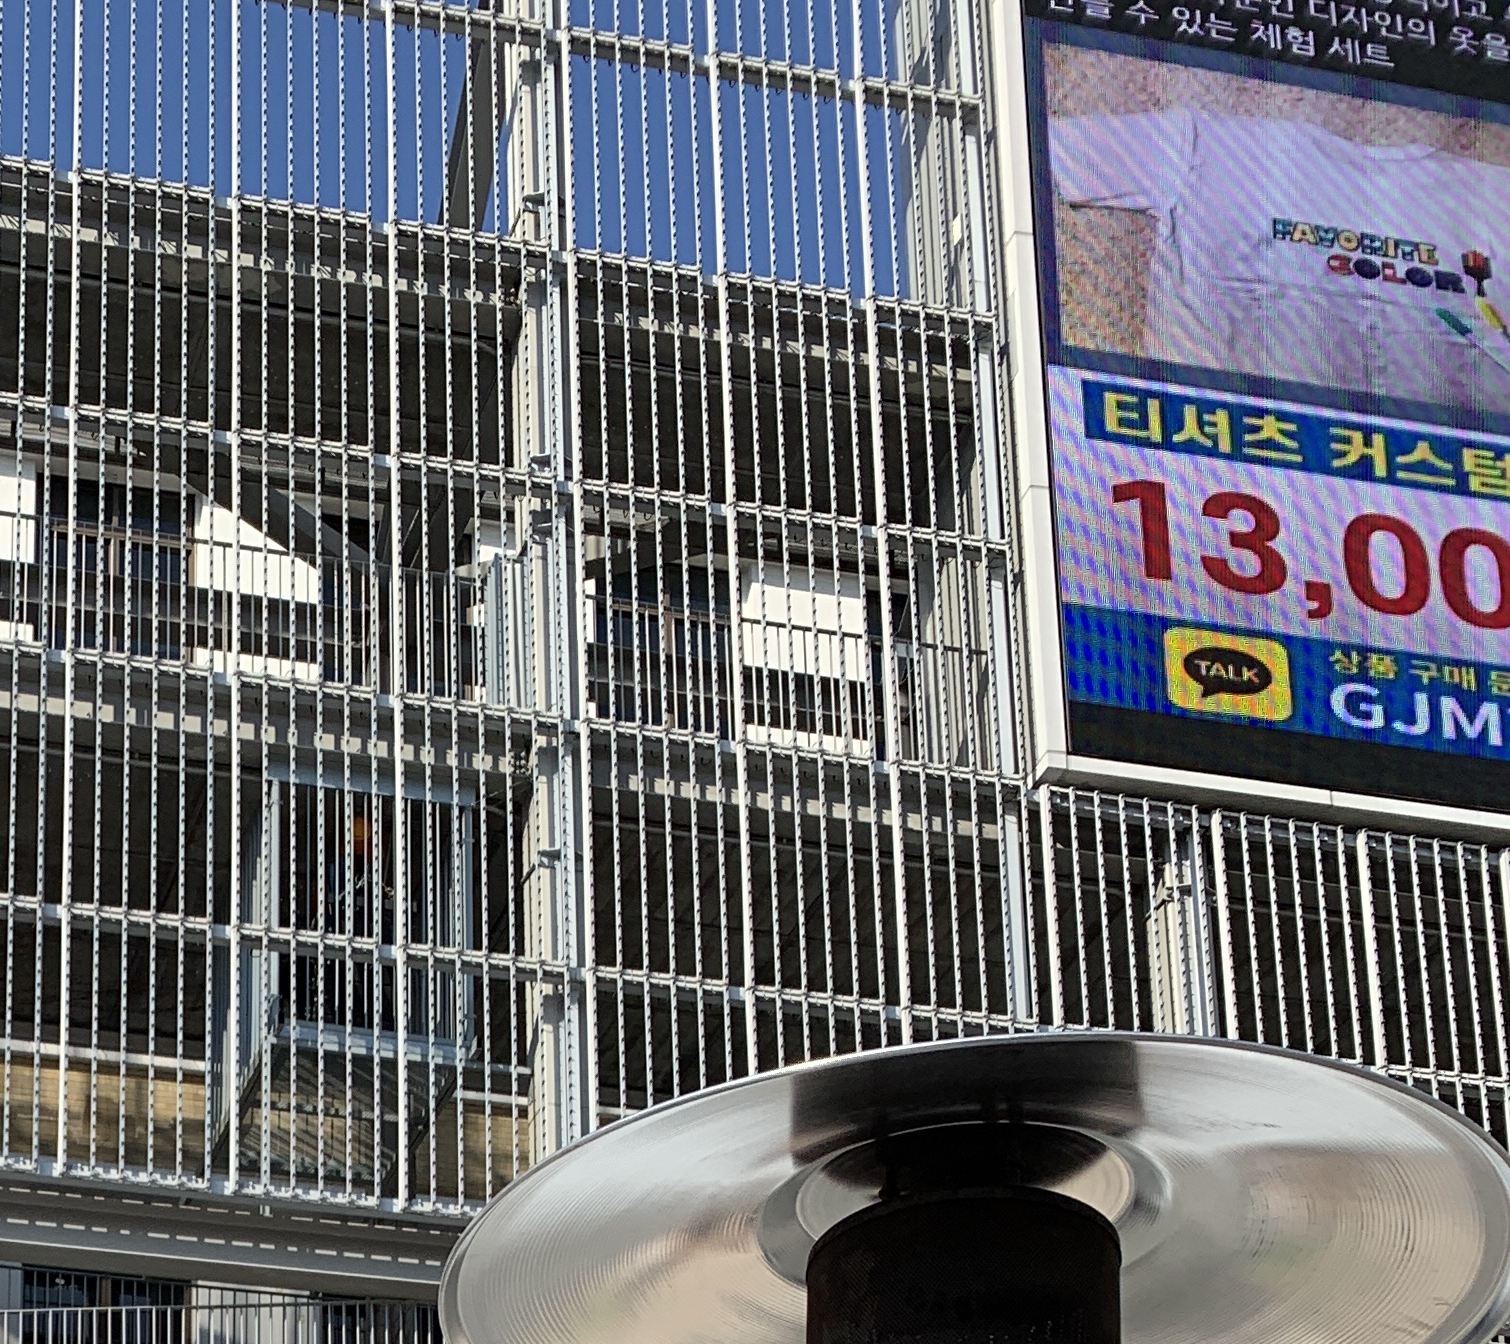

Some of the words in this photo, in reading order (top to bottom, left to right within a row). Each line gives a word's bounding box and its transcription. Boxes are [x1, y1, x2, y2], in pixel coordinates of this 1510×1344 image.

[1125, 2, 1160, 25] 수
[1172, 6, 1238, 42] 있는
[1250, 19, 1315, 57] 체험
[1327, 36, 1395, 67] 세트
[1309, 0, 1436, 46] 디자인의
[1273, 217, 1439, 266] FAVORITE
[1327, 253, 1466, 294] COLOR
[1102, 391, 1304, 464] 티셔츠
[1111, 478, 1510, 631] 13,00
[1194, 660, 1259, 686] TALK
[1328, 649, 1397, 680] 상품
[1408, 658, 1478, 692] 구매
[1330, 682, 1510, 747] GJM
